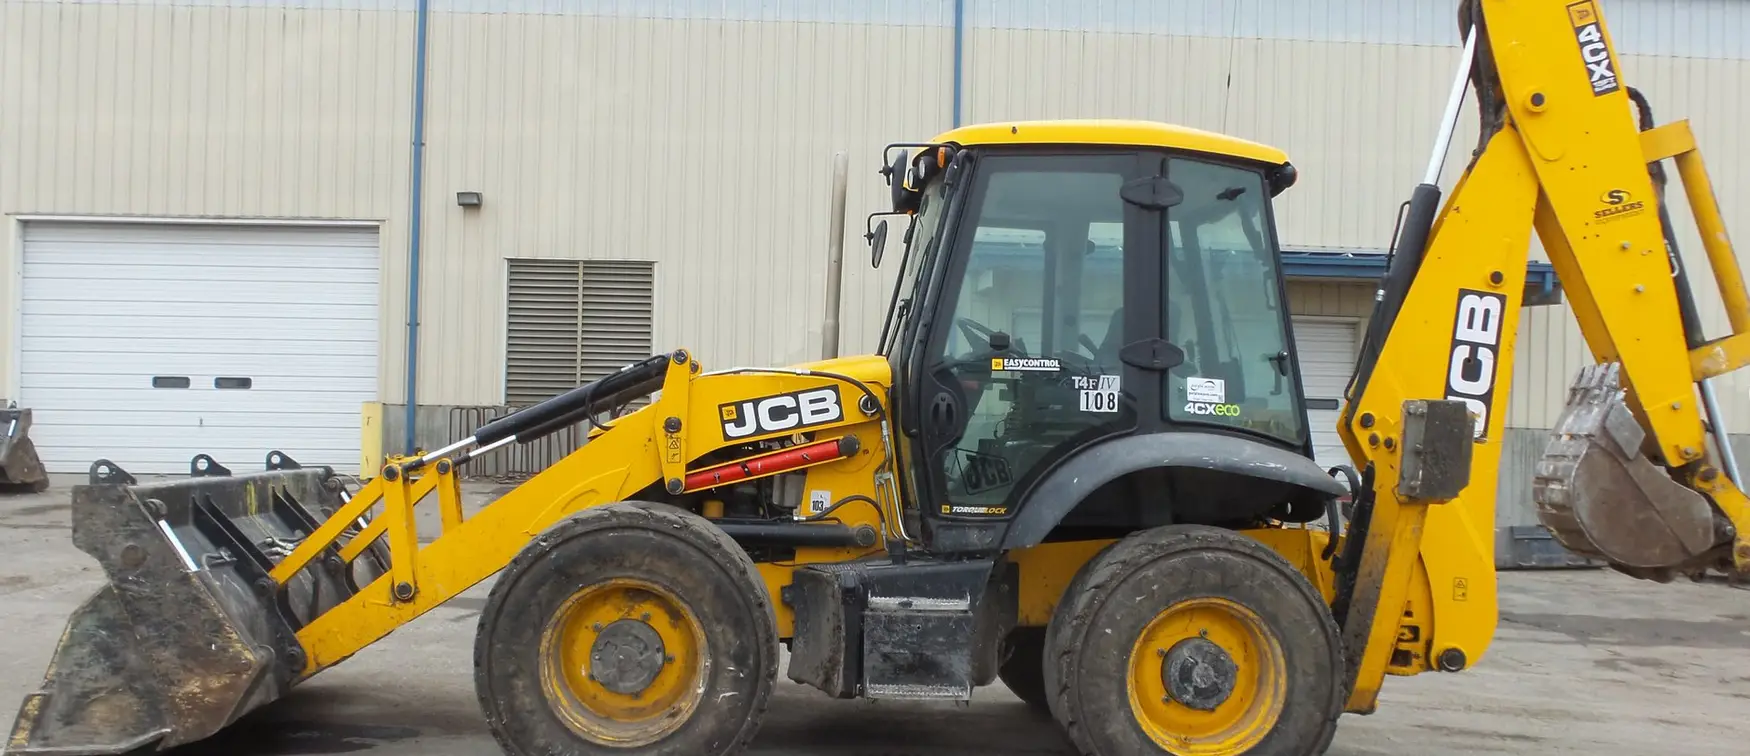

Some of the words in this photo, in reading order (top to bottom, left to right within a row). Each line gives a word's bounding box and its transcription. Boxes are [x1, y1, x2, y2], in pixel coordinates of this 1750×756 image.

[1578, 24, 1616, 82] 4CX
[1594, 200, 1644, 219] SELLERS
[1003, 358, 1060, 369] EASYCONTROL
[1084, 391, 1116, 410] 108
[1184, 402, 1241, 417] 4CXeco
[724, 389, 841, 437] JCB
